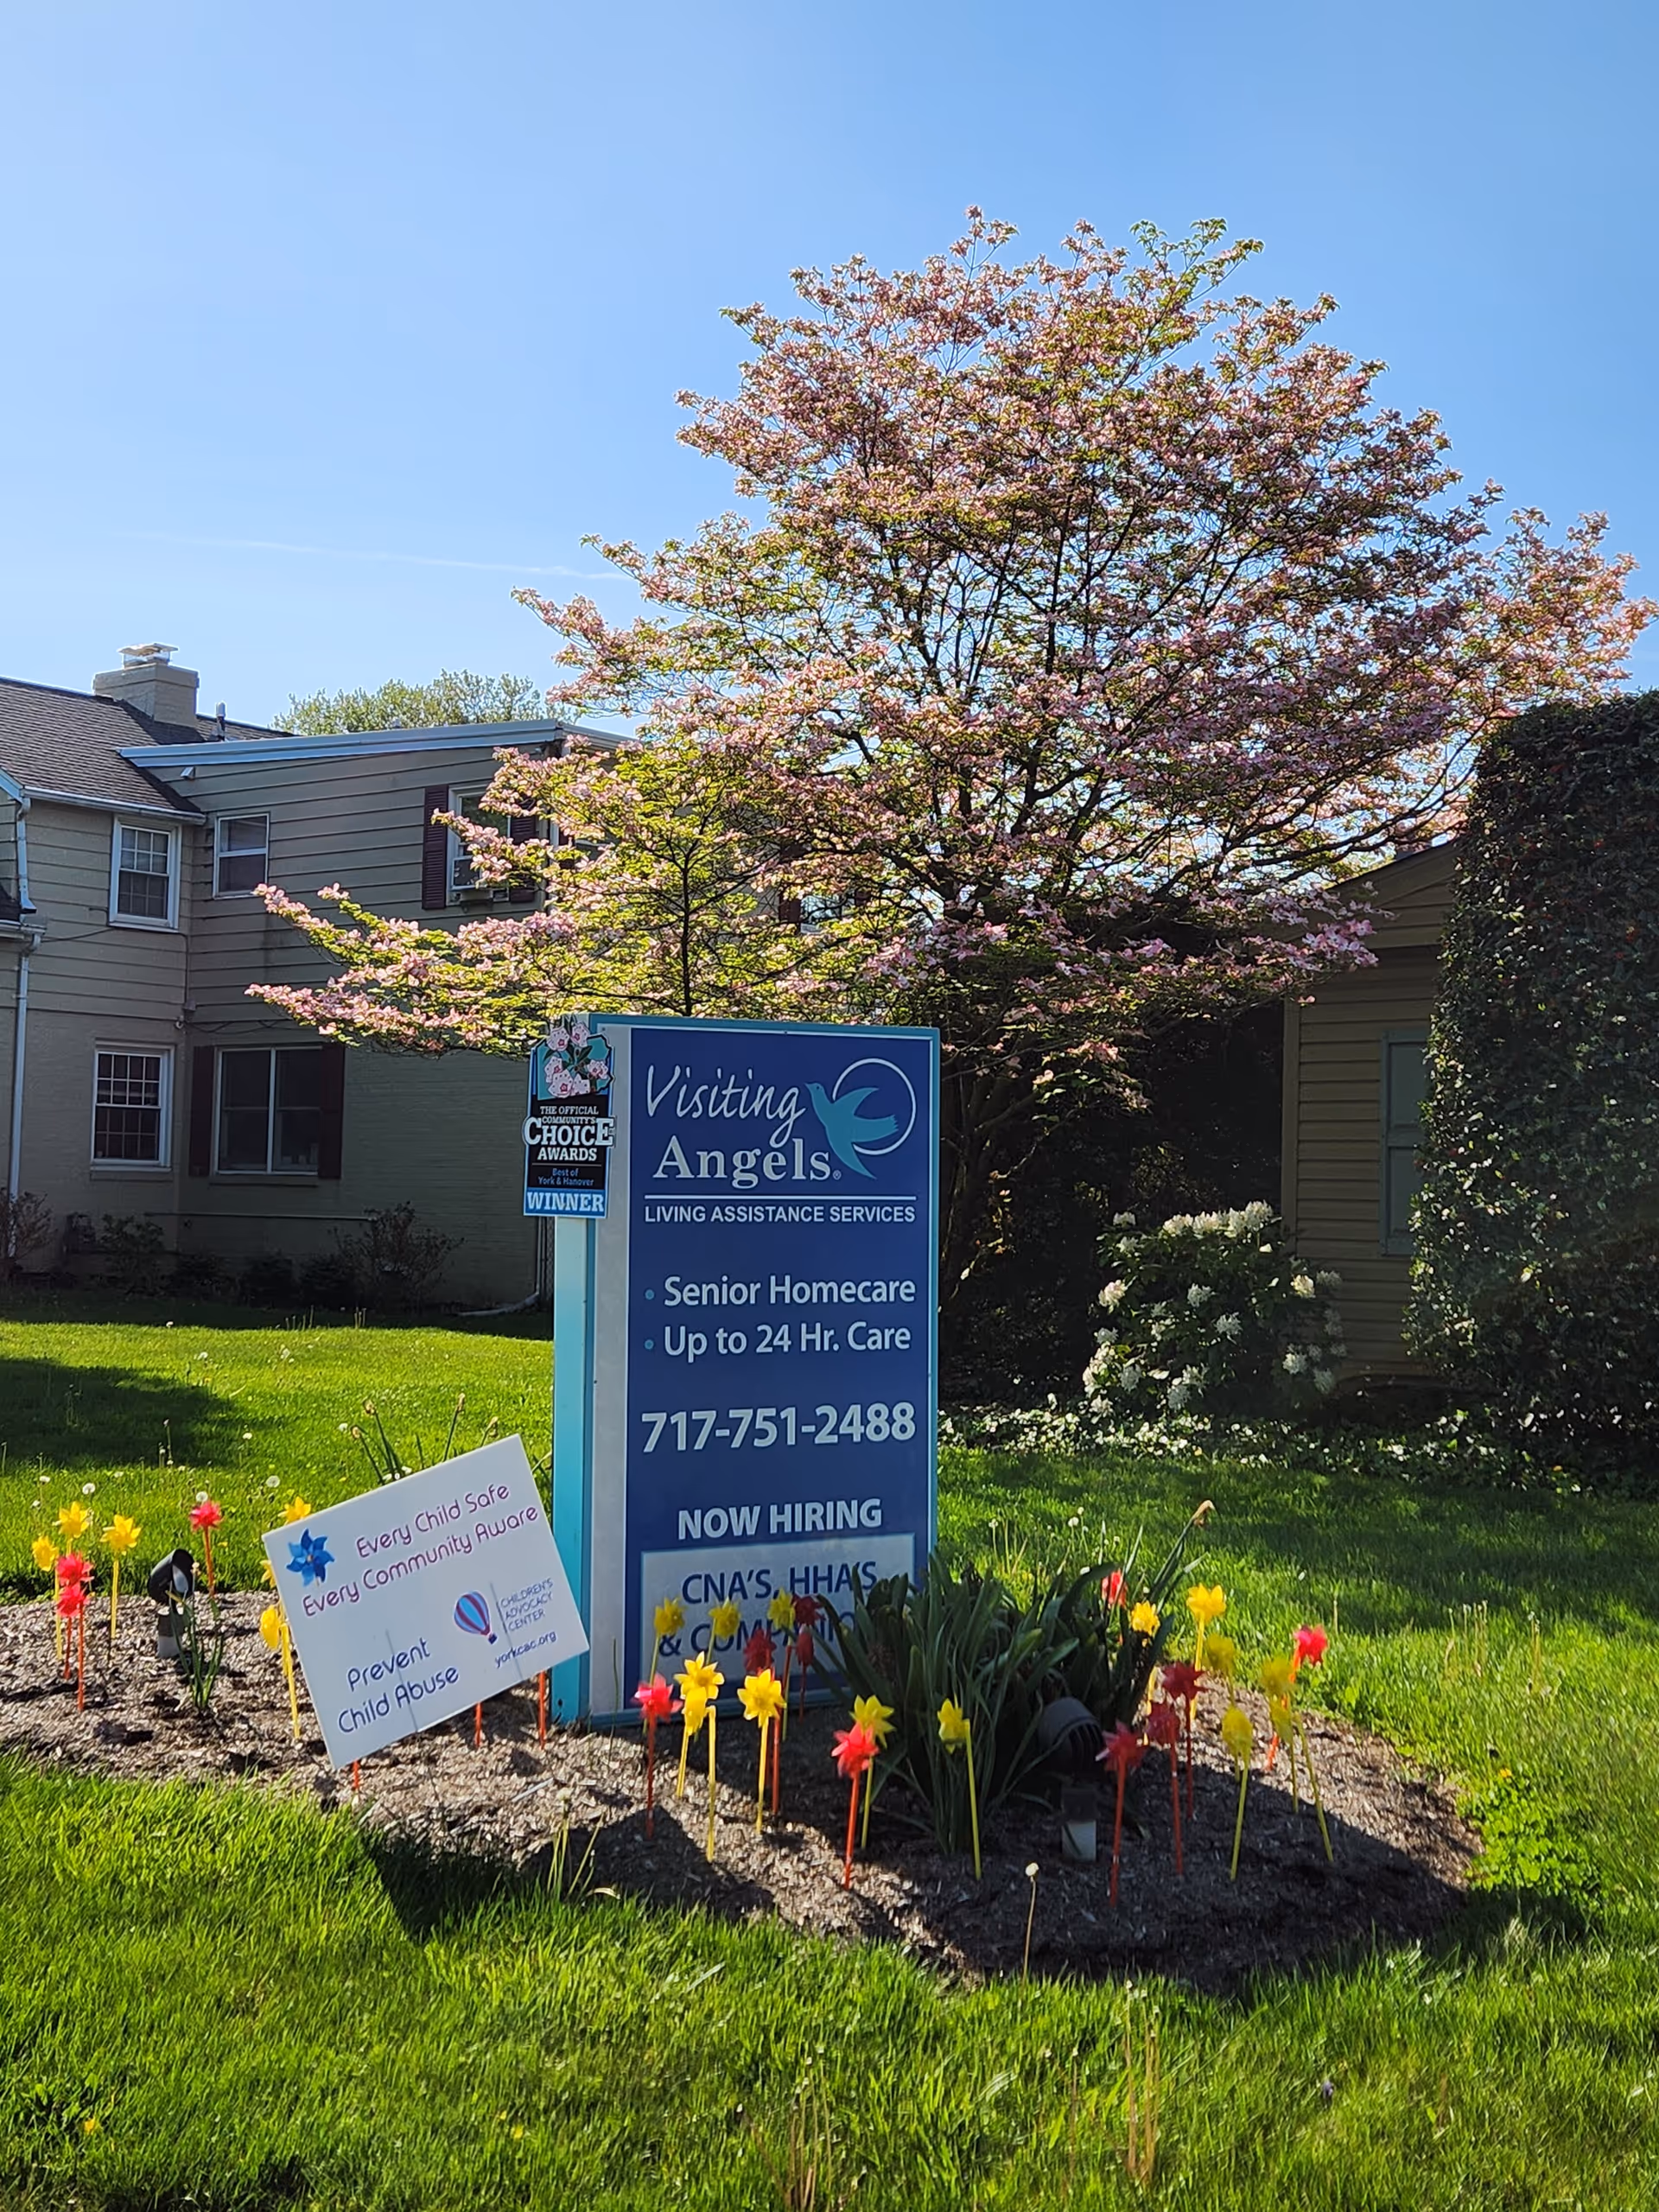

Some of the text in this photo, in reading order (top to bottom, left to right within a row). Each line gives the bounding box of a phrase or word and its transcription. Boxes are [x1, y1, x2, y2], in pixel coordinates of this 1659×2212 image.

[559, 1106, 599, 1115] OFFICIAL
[646, 1064, 807, 1147] Visiting
[524, 1117, 613, 1146] CHOICE
[537, 1147, 597, 1160] AWARDS
[526, 1192, 604, 1211] WINNER
[645, 1205, 916, 1223] LIVING ASSISTANCE SERVICES
[663, 1275, 916, 1306] Senior Homecare
[664, 1321, 912, 1363] Up to 24 Hr. Care
[641, 1402, 916, 1452] 717-751-2488
[356, 1483, 510, 1557] Every Child Safe
[677, 1498, 882, 1540] NOW HIRING
[302, 1504, 538, 1617] Every Community Aware
[501, 1578, 553, 1607] CHILDREN'S
[789, 1560, 877, 1595] HHA'S
[505, 1592, 552, 1620] ADVOCACY
[508, 1608, 545, 1631] CENTER
[658, 1633, 682, 1656] &
[347, 1637, 431, 1692] Prevent
[338, 1665, 460, 1733] Child Abuse
